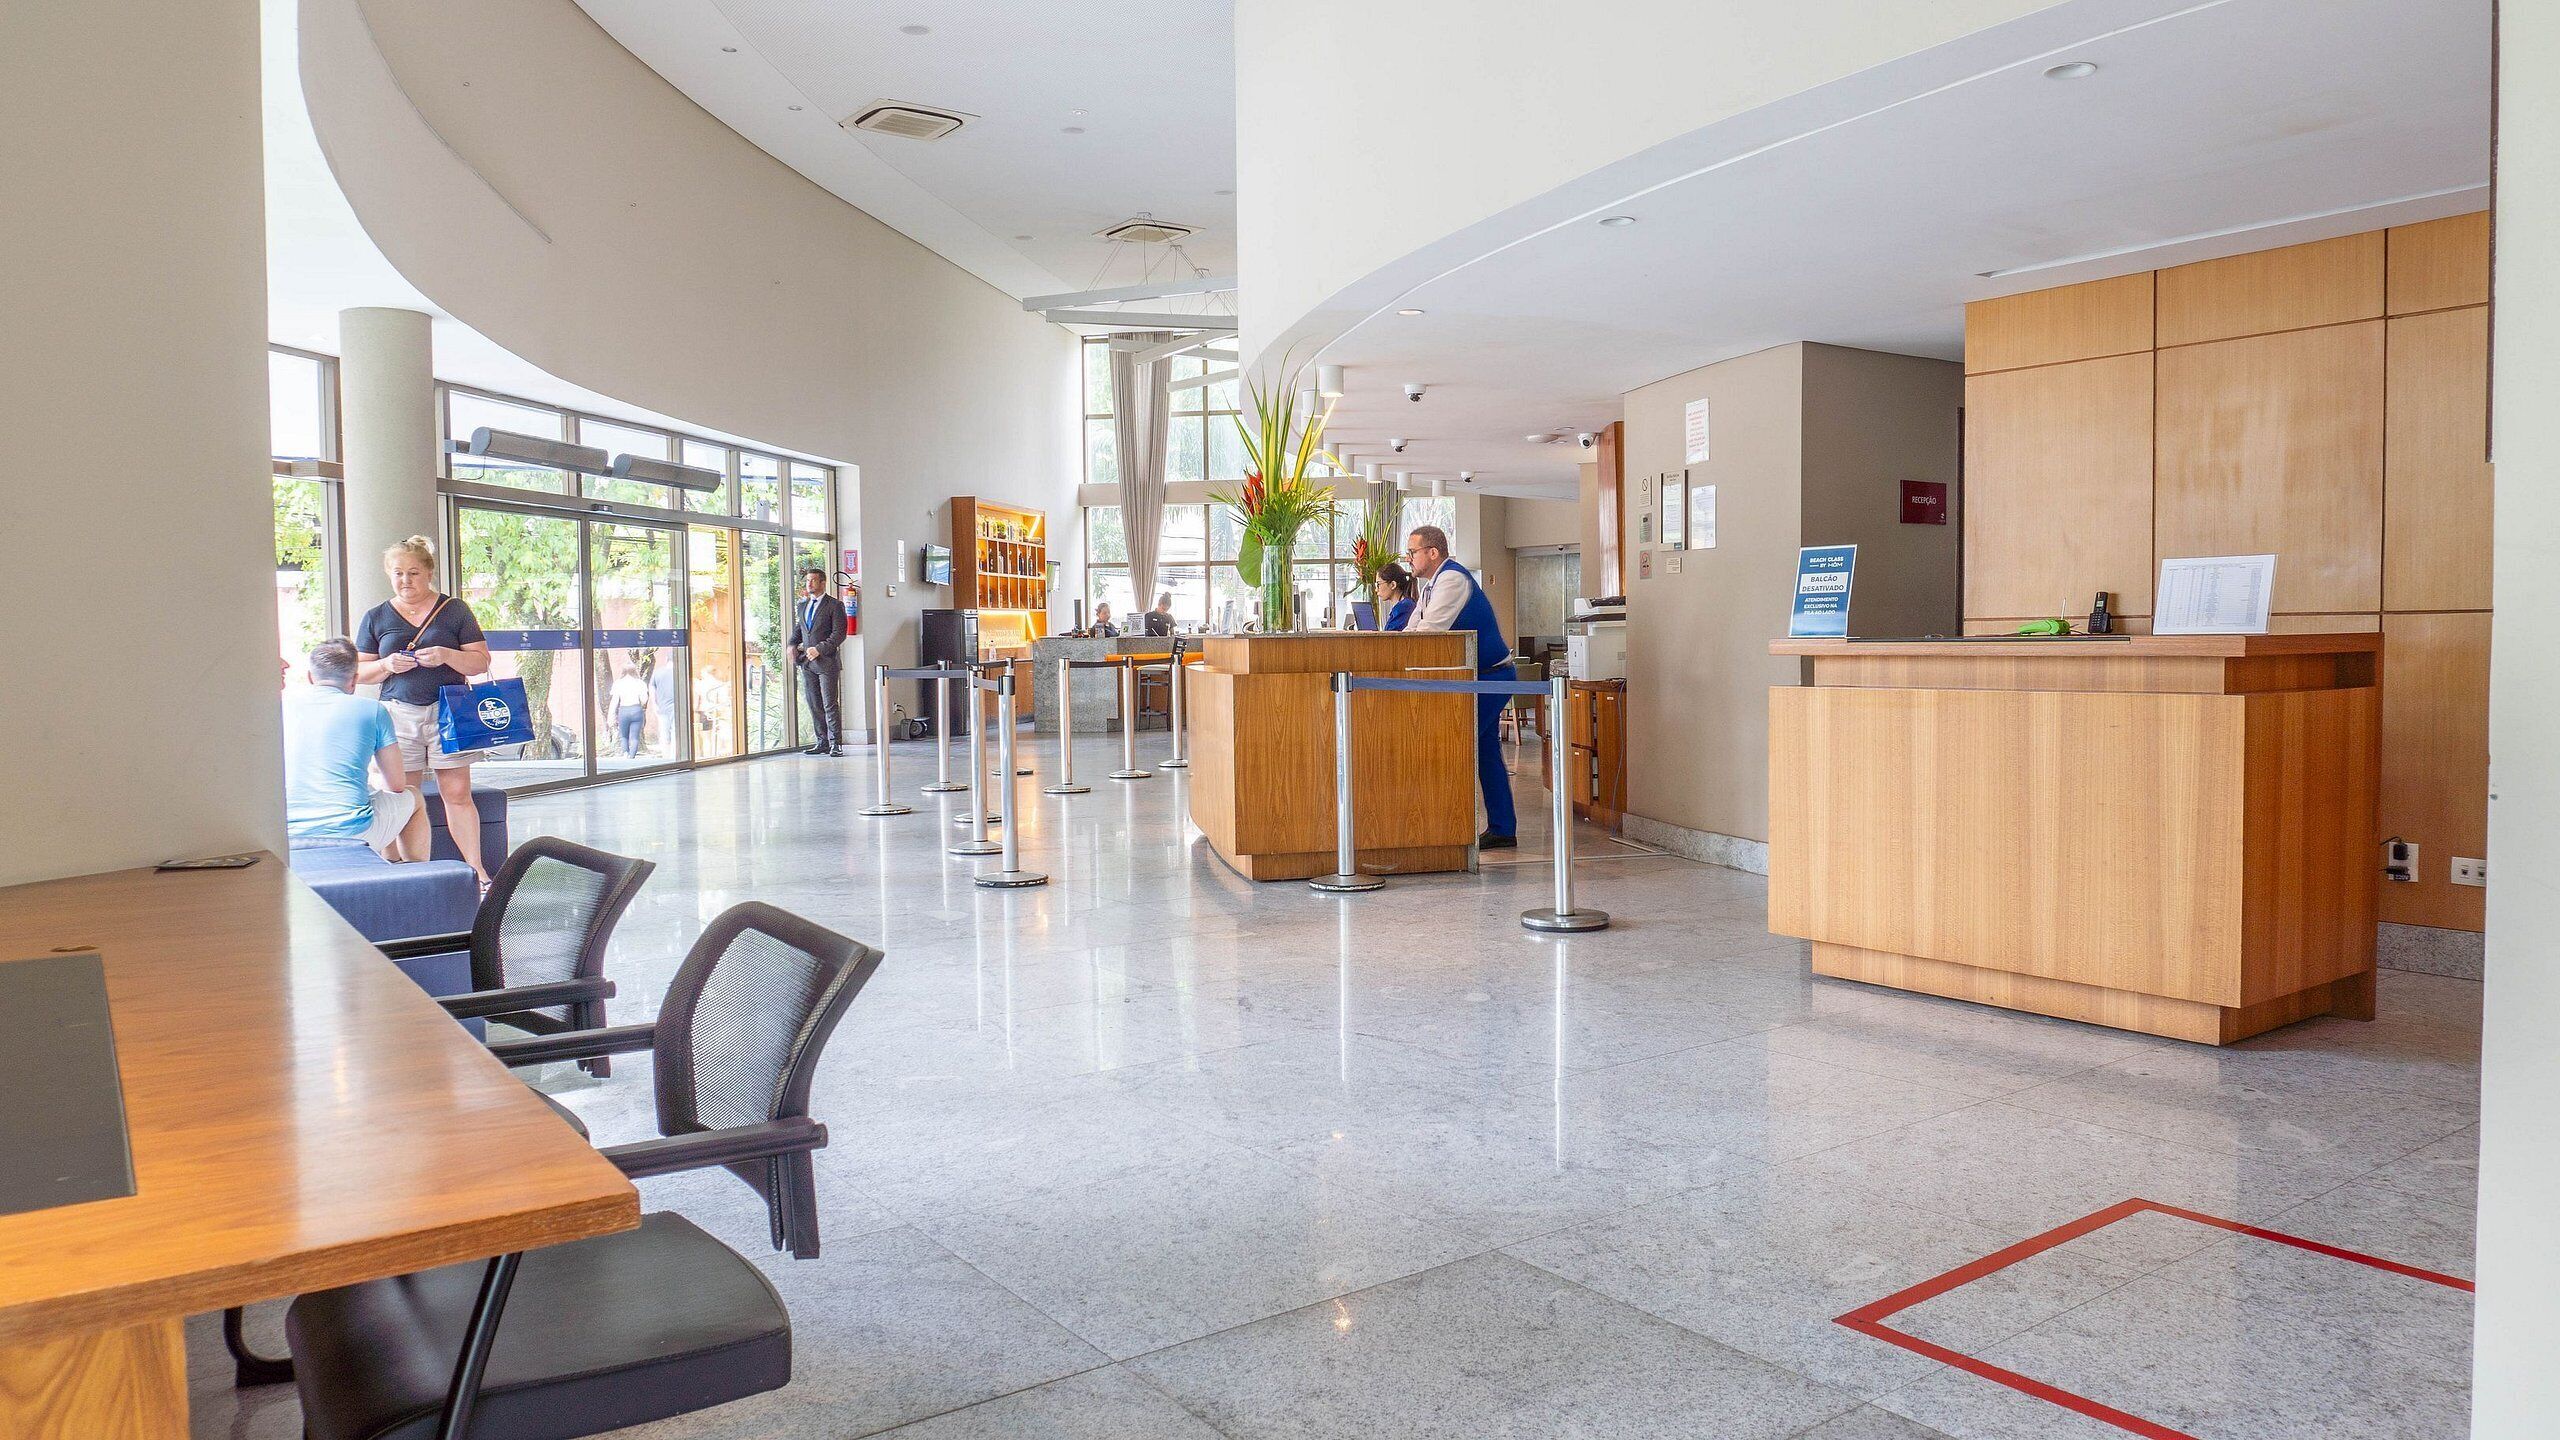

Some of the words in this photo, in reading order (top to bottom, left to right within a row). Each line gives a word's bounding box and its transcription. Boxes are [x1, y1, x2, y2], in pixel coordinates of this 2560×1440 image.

[1911, 495, 1937, 505] RECEPÇÃO
[1810, 574, 1838, 582] BALCÃO
[1801, 584, 1844, 592] DESATIVADO
